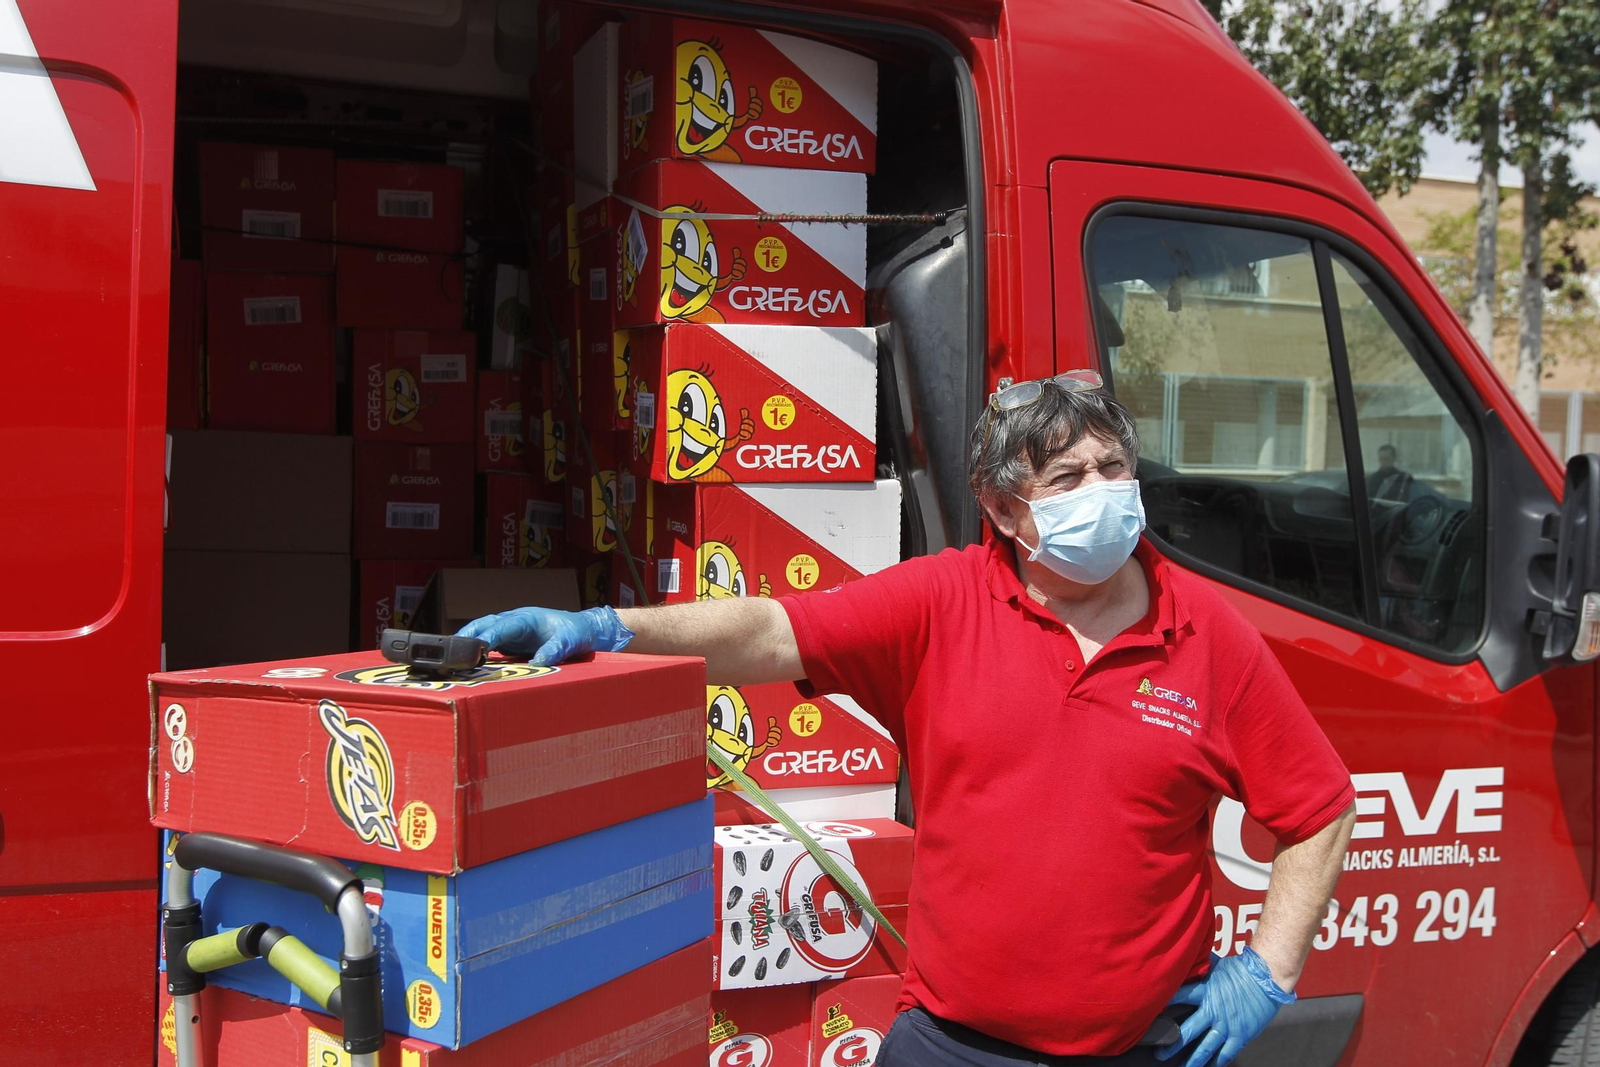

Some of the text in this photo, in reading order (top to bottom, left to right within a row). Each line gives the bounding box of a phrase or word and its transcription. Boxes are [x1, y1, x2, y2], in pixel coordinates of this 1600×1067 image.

[777, 89, 795, 109] 1€
[744, 125, 864, 162] GREFUSA
[761, 249, 779, 268] 1€
[728, 285, 850, 318] GREFUSA
[769, 407, 788, 426] 1€
[736, 444, 861, 473] GREFUSA
[794, 566, 812, 585] 1€
[796, 715, 814, 733] 1€
[763, 747, 884, 777] GREFUSA
[1397, 840, 1475, 867] ALMERÍA,
[1477, 847, 1501, 862] S.L.
[431, 897, 443, 959] NUEVO
[1312, 893, 1399, 951] 343
[1413, 886, 1497, 943] 294
[711, 1022, 731, 1034] NUEVO
[825, 1016, 846, 1028] NUEVO
[825, 1020, 849, 1034] FORMATO
[839, 1034, 857, 1045] PIPAS
